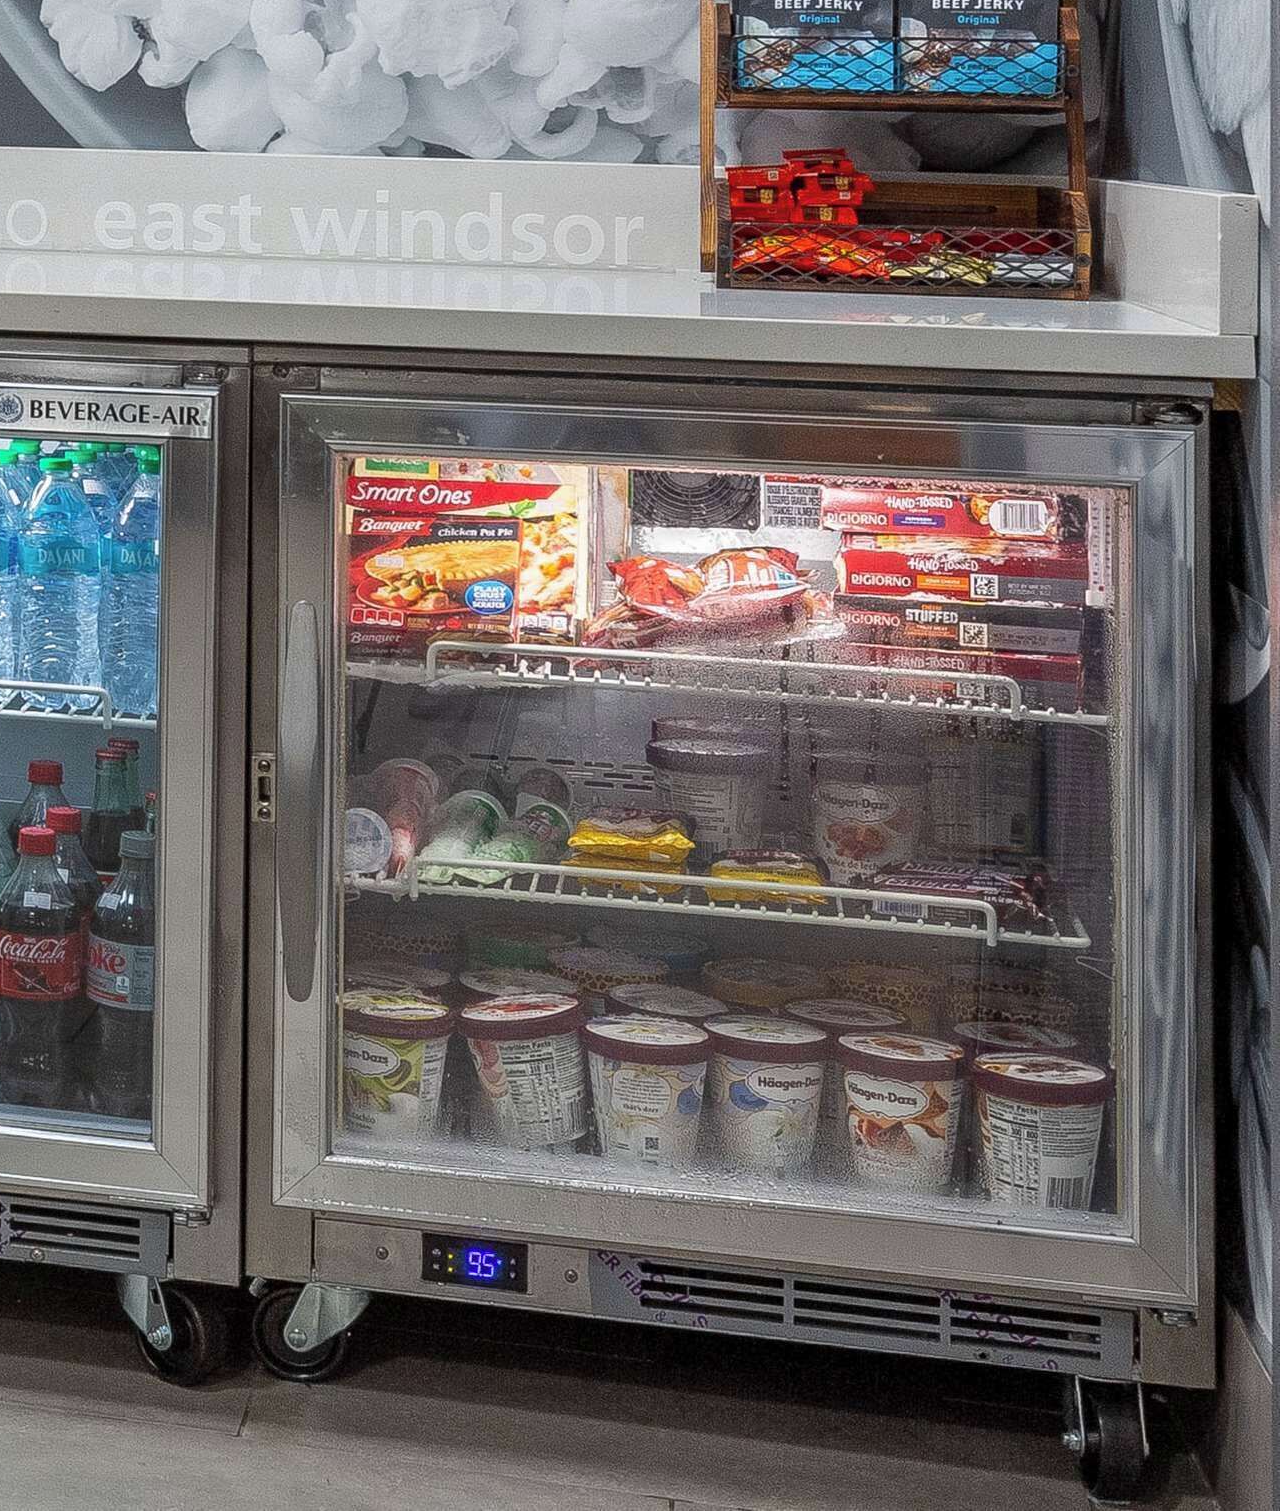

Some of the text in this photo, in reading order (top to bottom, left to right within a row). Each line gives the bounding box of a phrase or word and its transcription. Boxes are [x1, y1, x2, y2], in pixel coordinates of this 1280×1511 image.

[815, 0, 864, 11] JERKY
[799, 14, 840, 25] Original
[957, 14, 1000, 25] Original
[93, 193, 263, 252] east
[289, 189, 644, 267] windsor
[352, 481, 472, 505] Smart Ones
[884, 495, 953, 510] HAND-TOSSED
[358, 517, 422, 533] Banquet
[438, 528, 513, 537] Chicken Pot Pie
[38, 546, 85, 567] DASANI
[121, 547, 159, 567] DASAN
[907, 556, 979, 573] HAND-TOSSED
[473, 591, 505, 599] CRUST
[473, 601, 506, 609] SCRATCH
[905, 608, 958, 624] STUFFED
[351, 632, 402, 644] Banquet
